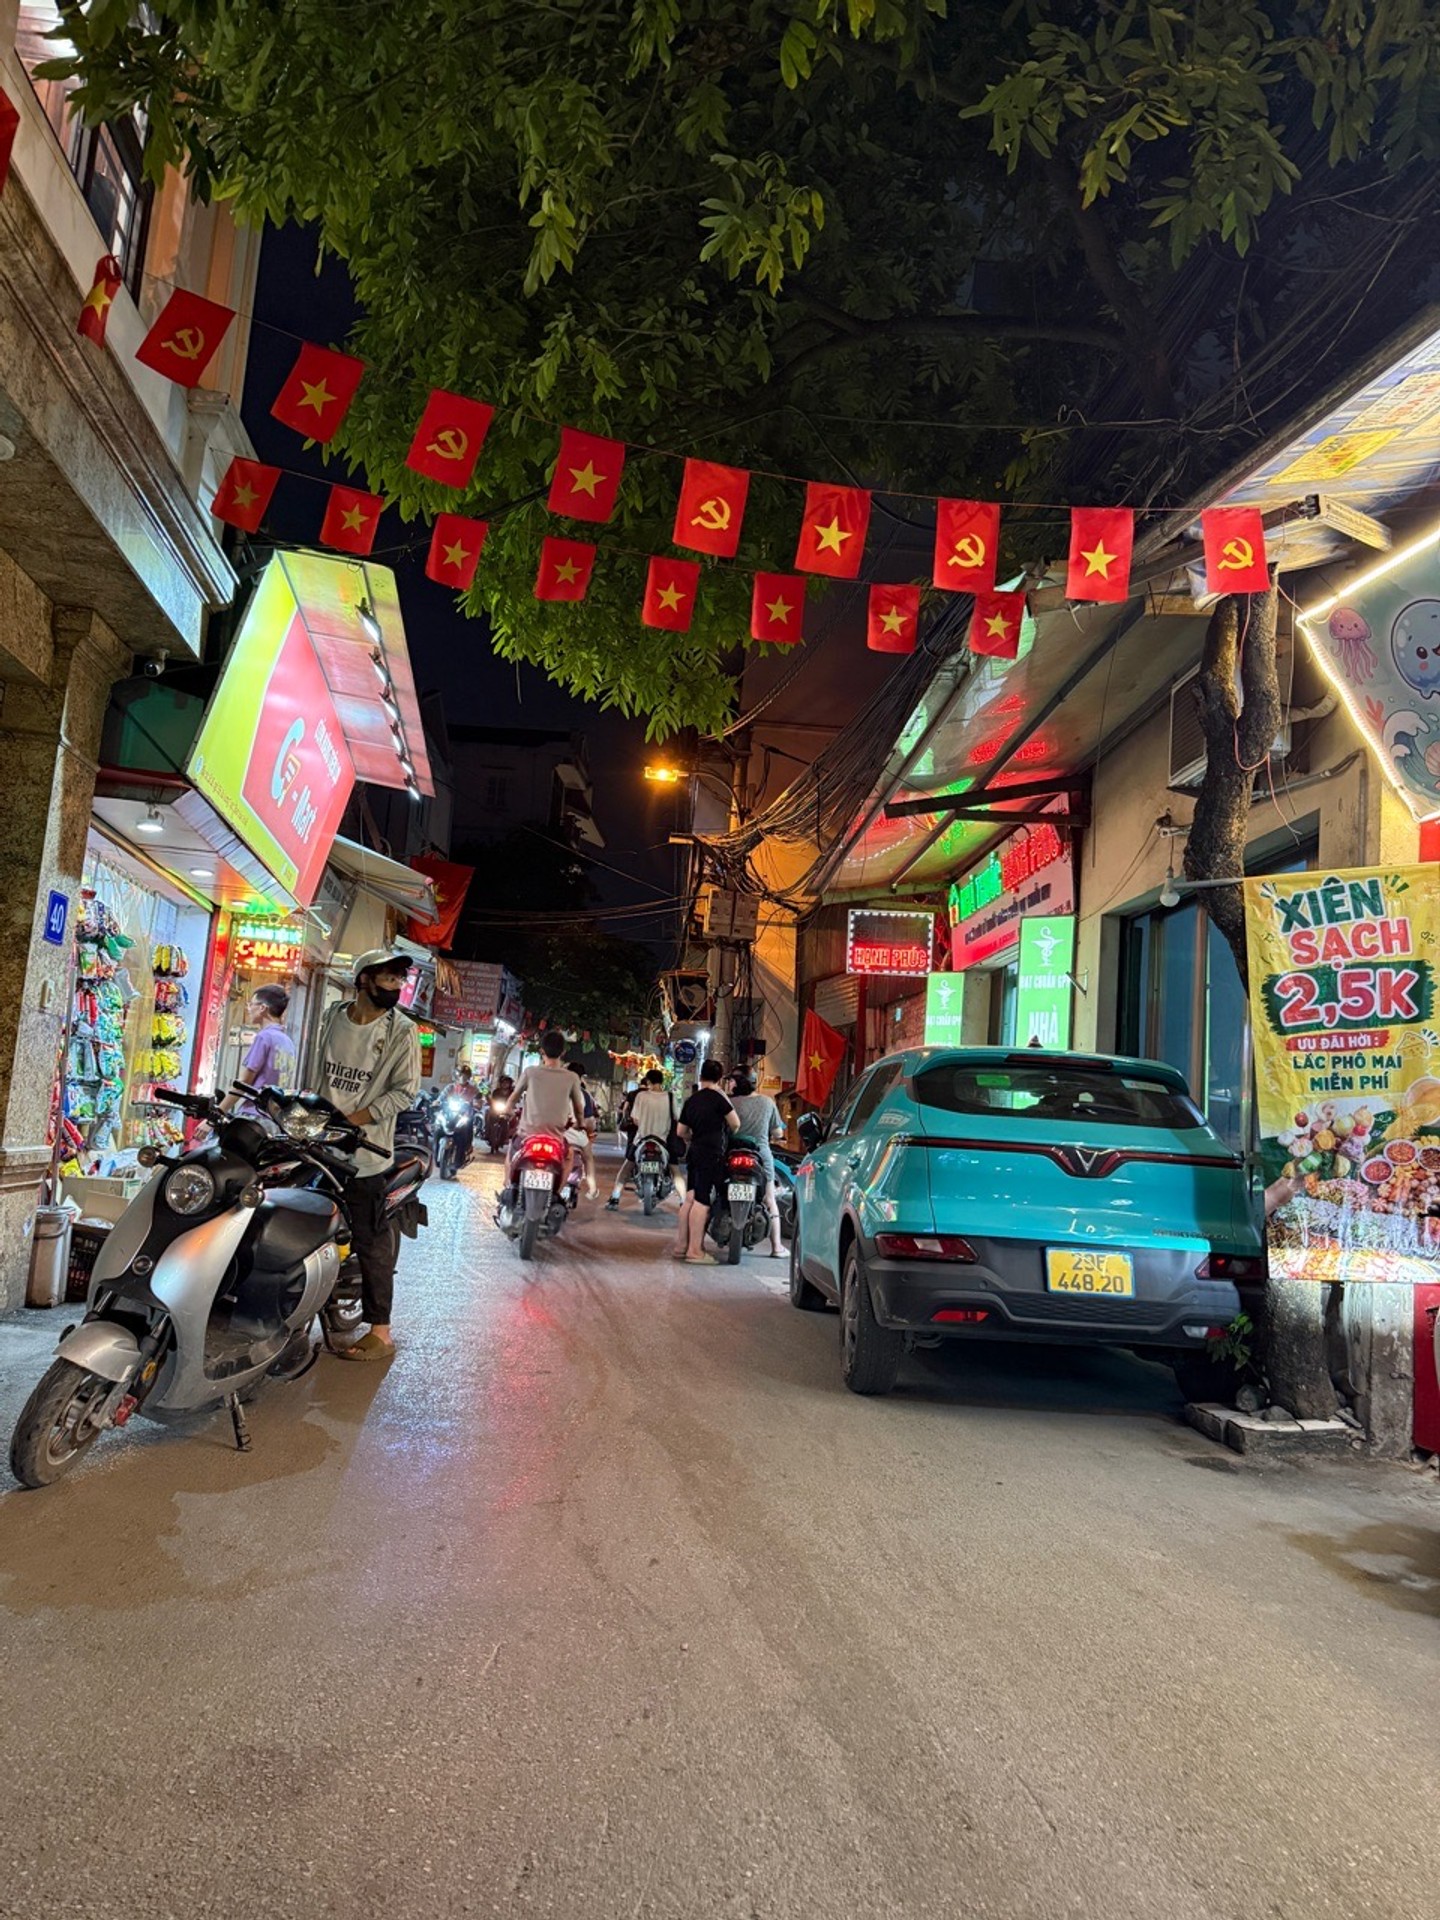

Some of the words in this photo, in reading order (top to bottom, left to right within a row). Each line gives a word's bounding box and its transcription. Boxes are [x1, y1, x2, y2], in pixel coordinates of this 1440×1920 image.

[1275, 877, 1384, 933] XIÊN
[50, 903, 64, 934] 40
[238, 940, 301, 960] C-MART
[1290, 919, 1410, 969] SẠCH
[854, 947, 891, 969] HẠNH
[891, 946, 927, 969] PHÚC
[1276, 971, 1418, 1024] 2,5K
[1297, 1037, 1316, 1050] ƯU
[1320, 1034, 1344, 1049] ĐÃI
[1293, 1052, 1326, 1069] LẮC
[1331, 1051, 1366, 1069] PHÔ
[1372, 1054, 1402, 1069] MAI
[325, 1061, 374, 1083] mirates
[1309, 1072, 1354, 1091] MIỄN
[1359, 1071, 1389, 1089] PHÍ
[330, 1077, 361, 1094] BETTER
[1058, 1272, 1124, 1293] 448.20
